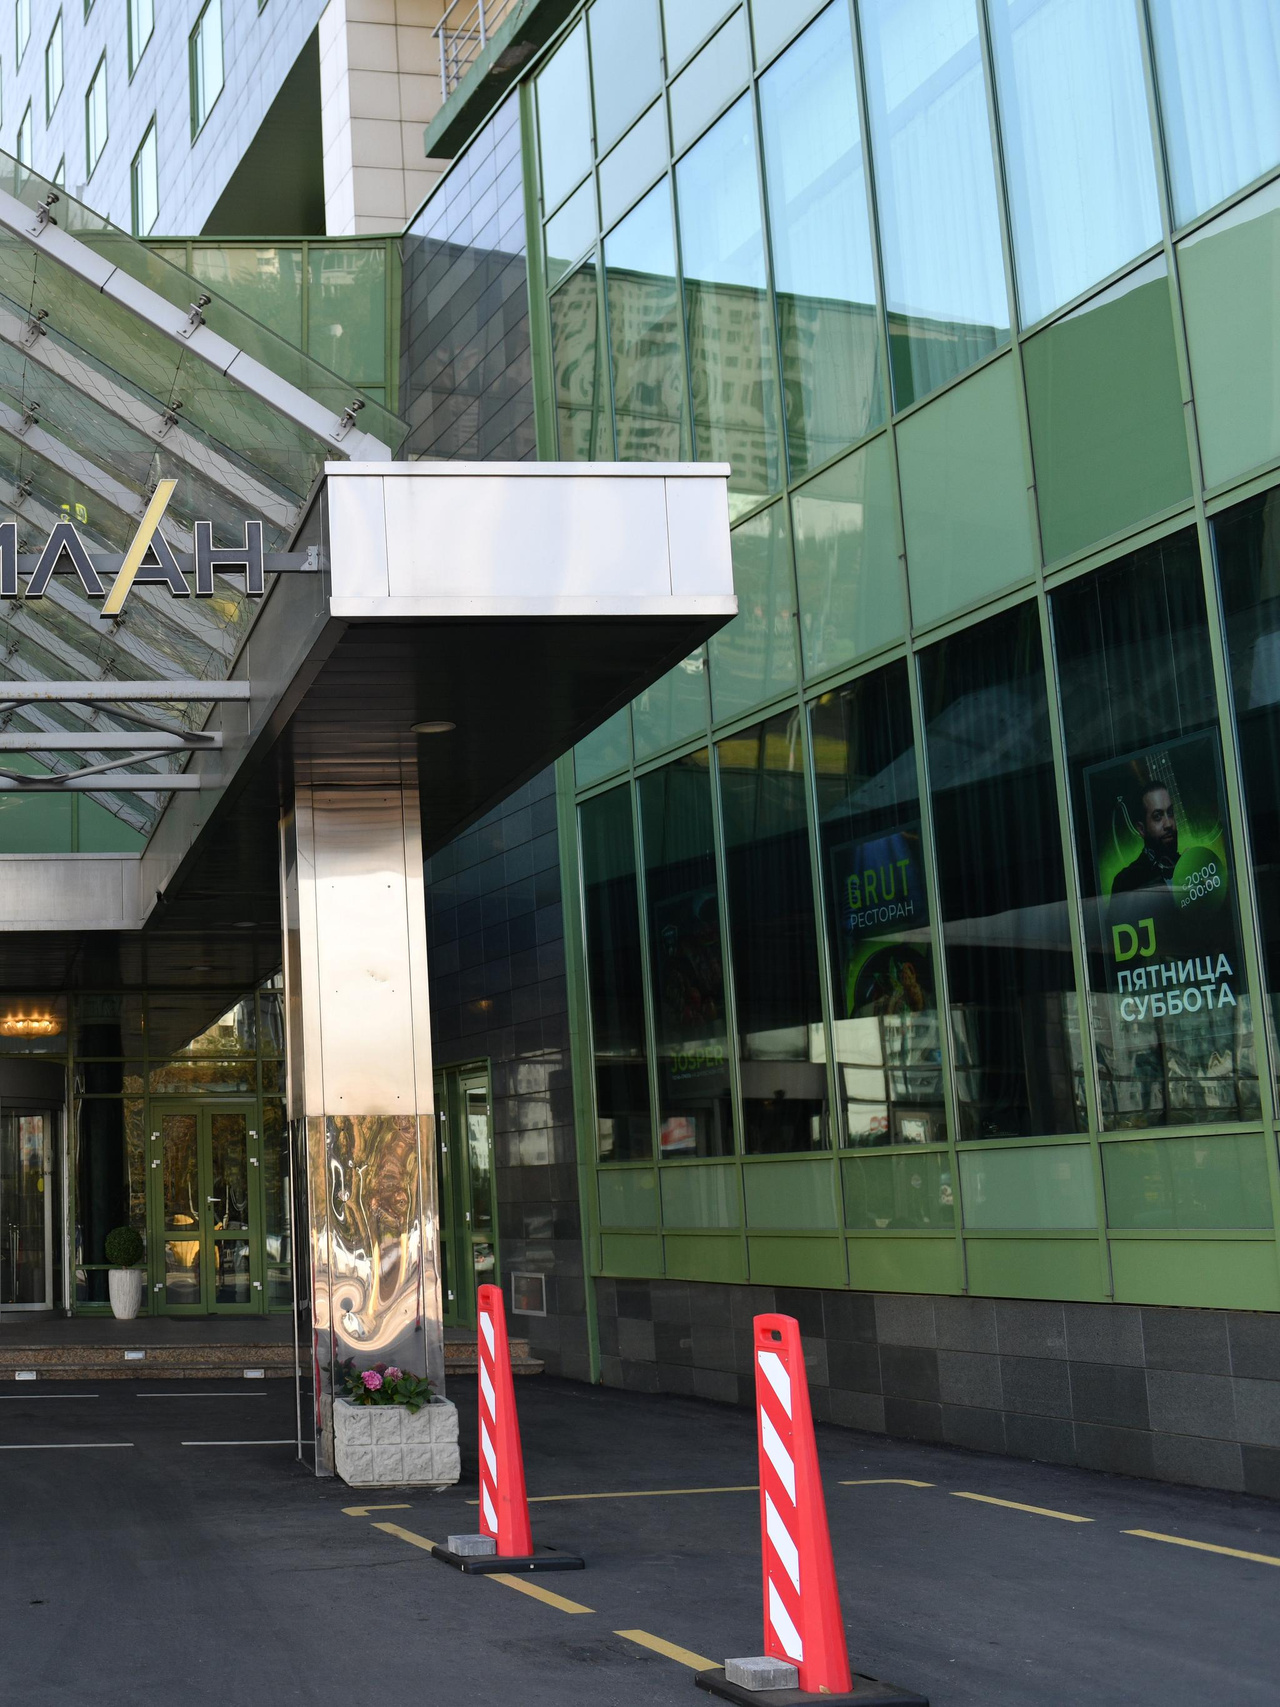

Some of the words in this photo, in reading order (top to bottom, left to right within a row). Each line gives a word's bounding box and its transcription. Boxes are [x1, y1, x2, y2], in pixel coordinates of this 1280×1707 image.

[847, 858, 910, 909] GRUT
[1189, 875, 1221, 901] 00:00
[850, 900, 914, 930] РЕСТОРАН
[1112, 918, 1157, 962] DJ
[1117, 953, 1233, 993] ПЯТНИЦА
[1120, 982, 1237, 1022] СУББОТА
